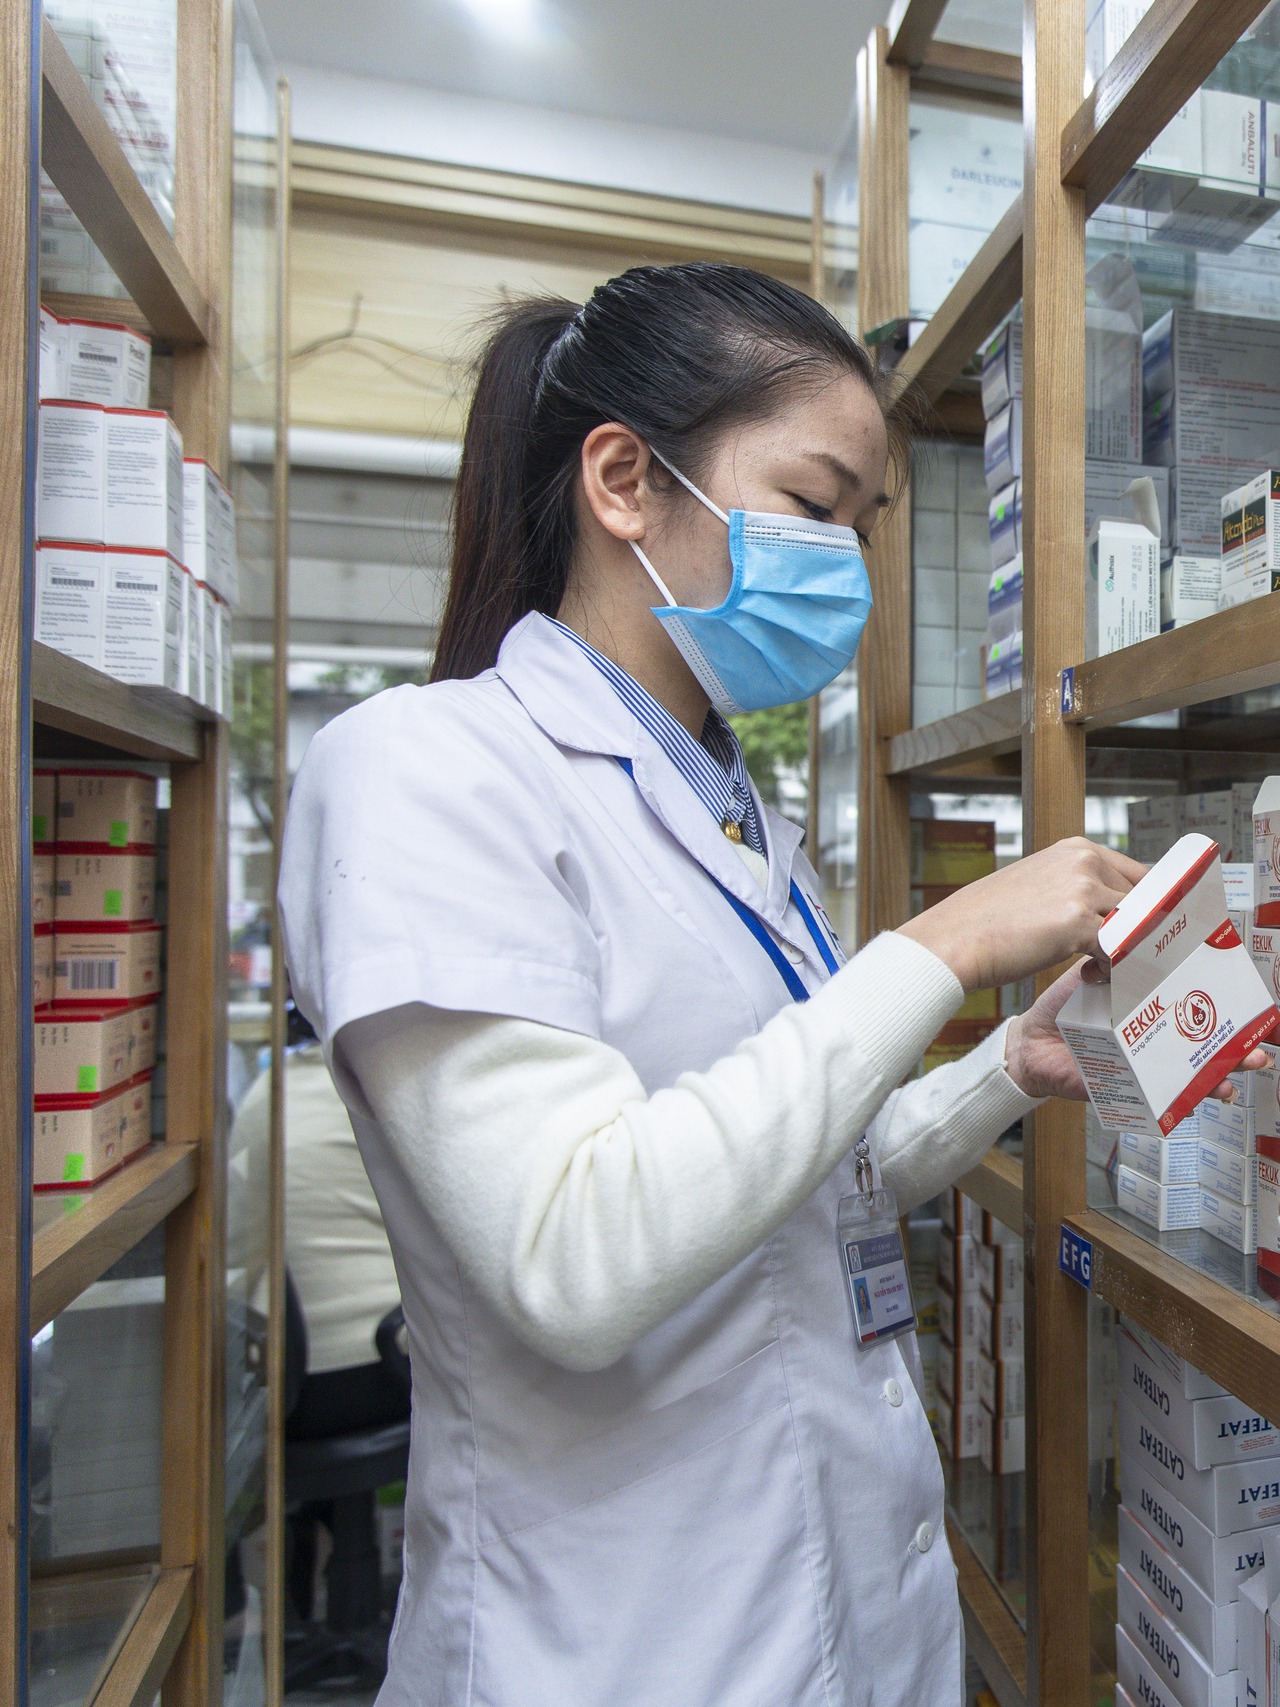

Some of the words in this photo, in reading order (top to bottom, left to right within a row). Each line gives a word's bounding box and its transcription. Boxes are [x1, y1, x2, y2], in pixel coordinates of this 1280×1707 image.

[1247, 111, 1255, 176] ANBALUTI
[1155, 914, 1188, 958] FEKUK
[1214, 924, 1233, 944] WHO-GMP
[1252, 934, 1273, 952] FEKUK
[1121, 995, 1165, 1045] FEKUK
[1131, 1041, 1146, 1056] Dung
[1154, 1020, 1167, 1034] uống
[1194, 1013, 1203, 1024] Fe
[1243, 1039, 1253, 1050] Hộp
[1252, 1033, 1258, 1041] 20
[1270, 1015, 1276, 1023] ml
[1189, 1049, 1201, 1064] NGĂN
[1200, 1040, 1212, 1052] NGỪA
[1217, 1024, 1227, 1035] ĐIỀU
[1192, 1057, 1203, 1070] THIẾU
[1202, 1047, 1213, 1059] MÁU
[1212, 1042, 1219, 1050] DO
[1218, 1033, 1229, 1045] THIẾU
[1258, 1160, 1279, 1184] FEKUK
[1133, 1363, 1170, 1416] CATEFAT
[1218, 1418, 1272, 1438] TEFAT
[1139, 1425, 1184, 1481] CATEFAT
[1140, 1488, 1184, 1548] CATEFAT
[1139, 1549, 1183, 1612] CATEFAT
[1138, 1611, 1180, 1679] CATEFAT
